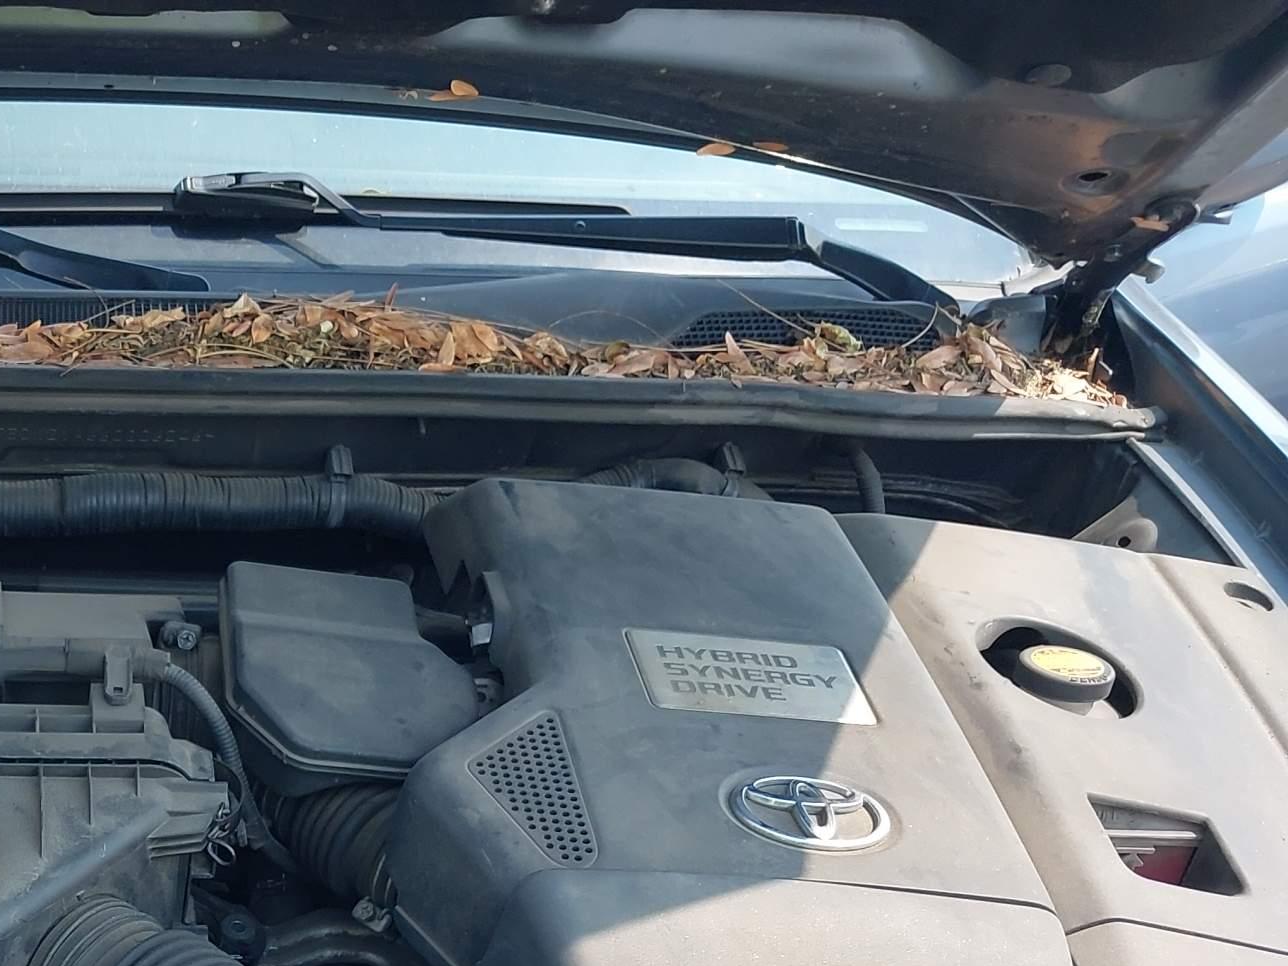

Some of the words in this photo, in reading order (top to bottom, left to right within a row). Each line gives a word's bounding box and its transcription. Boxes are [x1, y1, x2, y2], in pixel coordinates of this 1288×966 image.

[655, 644, 798, 668] HYBRID
[662, 661, 838, 689] SYNERGY
[671, 679, 787, 701] DRIVE
